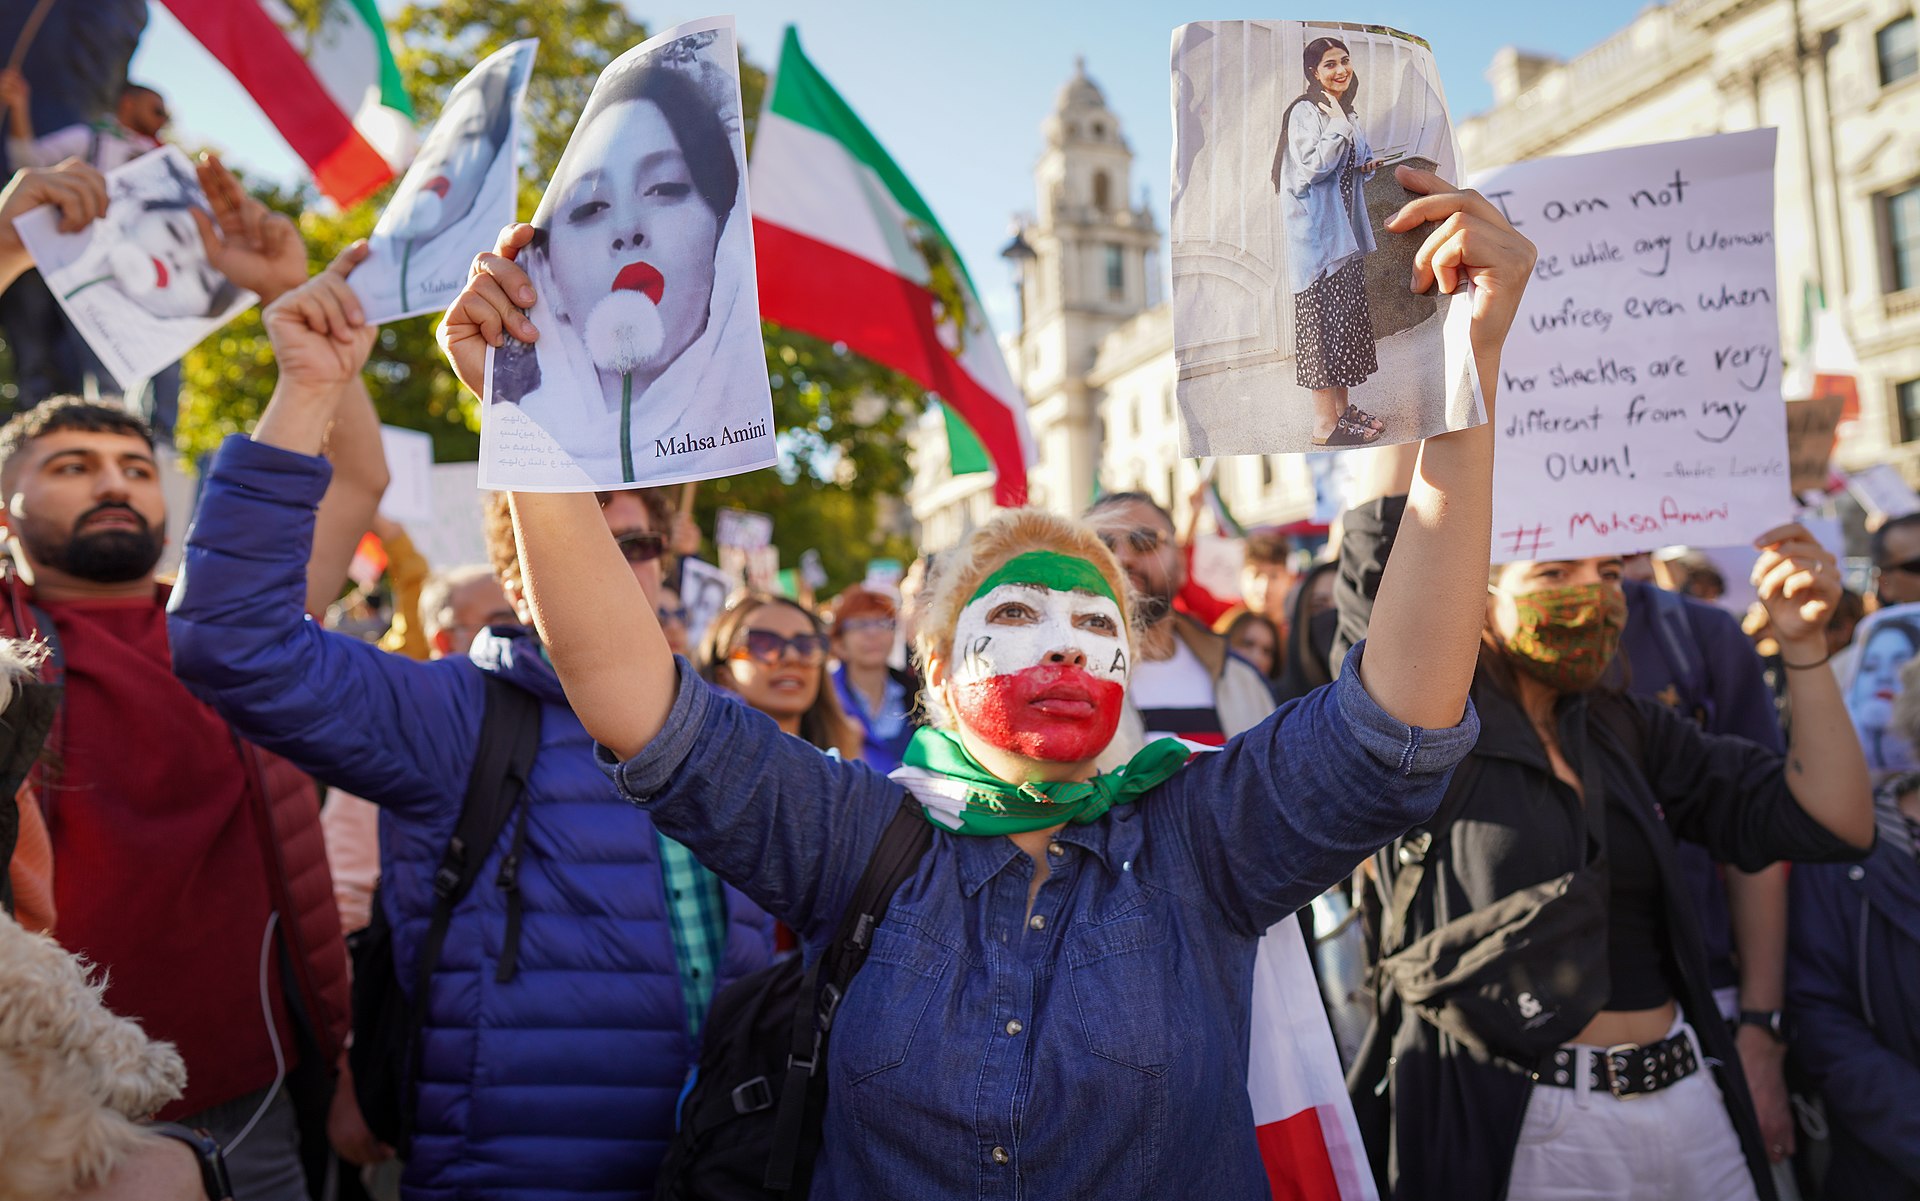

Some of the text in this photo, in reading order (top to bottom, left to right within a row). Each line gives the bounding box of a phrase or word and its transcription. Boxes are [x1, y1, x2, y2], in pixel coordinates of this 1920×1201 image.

[1488, 169, 1690, 227] I am not
[1535, 255, 1563, 280] ee
[1571, 241, 1623, 268] while
[1633, 235, 1672, 277] any
[1624, 296, 1685, 319] even
[1697, 283, 1772, 312] when
[1649, 355, 1688, 378] are
[1714, 345, 1773, 392] very
[655, 418, 767, 458] Mahsa Amini
[1505, 408, 1602, 438] different
[1626, 394, 1687, 427] from
[1695, 400, 1747, 443] my
